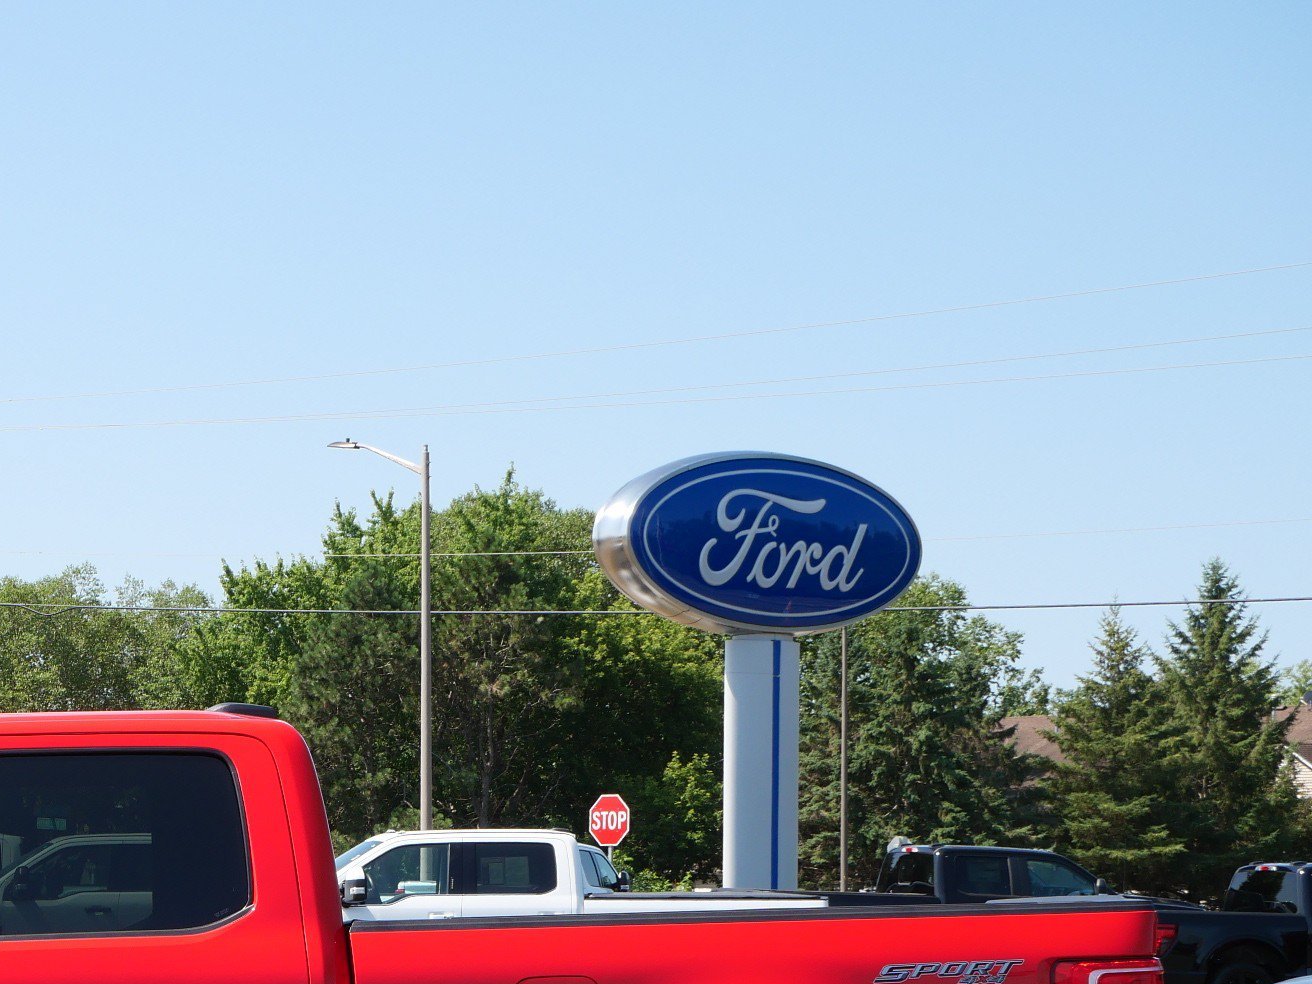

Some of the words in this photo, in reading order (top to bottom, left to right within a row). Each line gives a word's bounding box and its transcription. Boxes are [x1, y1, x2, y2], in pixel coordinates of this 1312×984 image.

[699, 488, 868, 592] Ford
[591, 810, 627, 830] STOP
[873, 959, 1025, 984] SPORT
